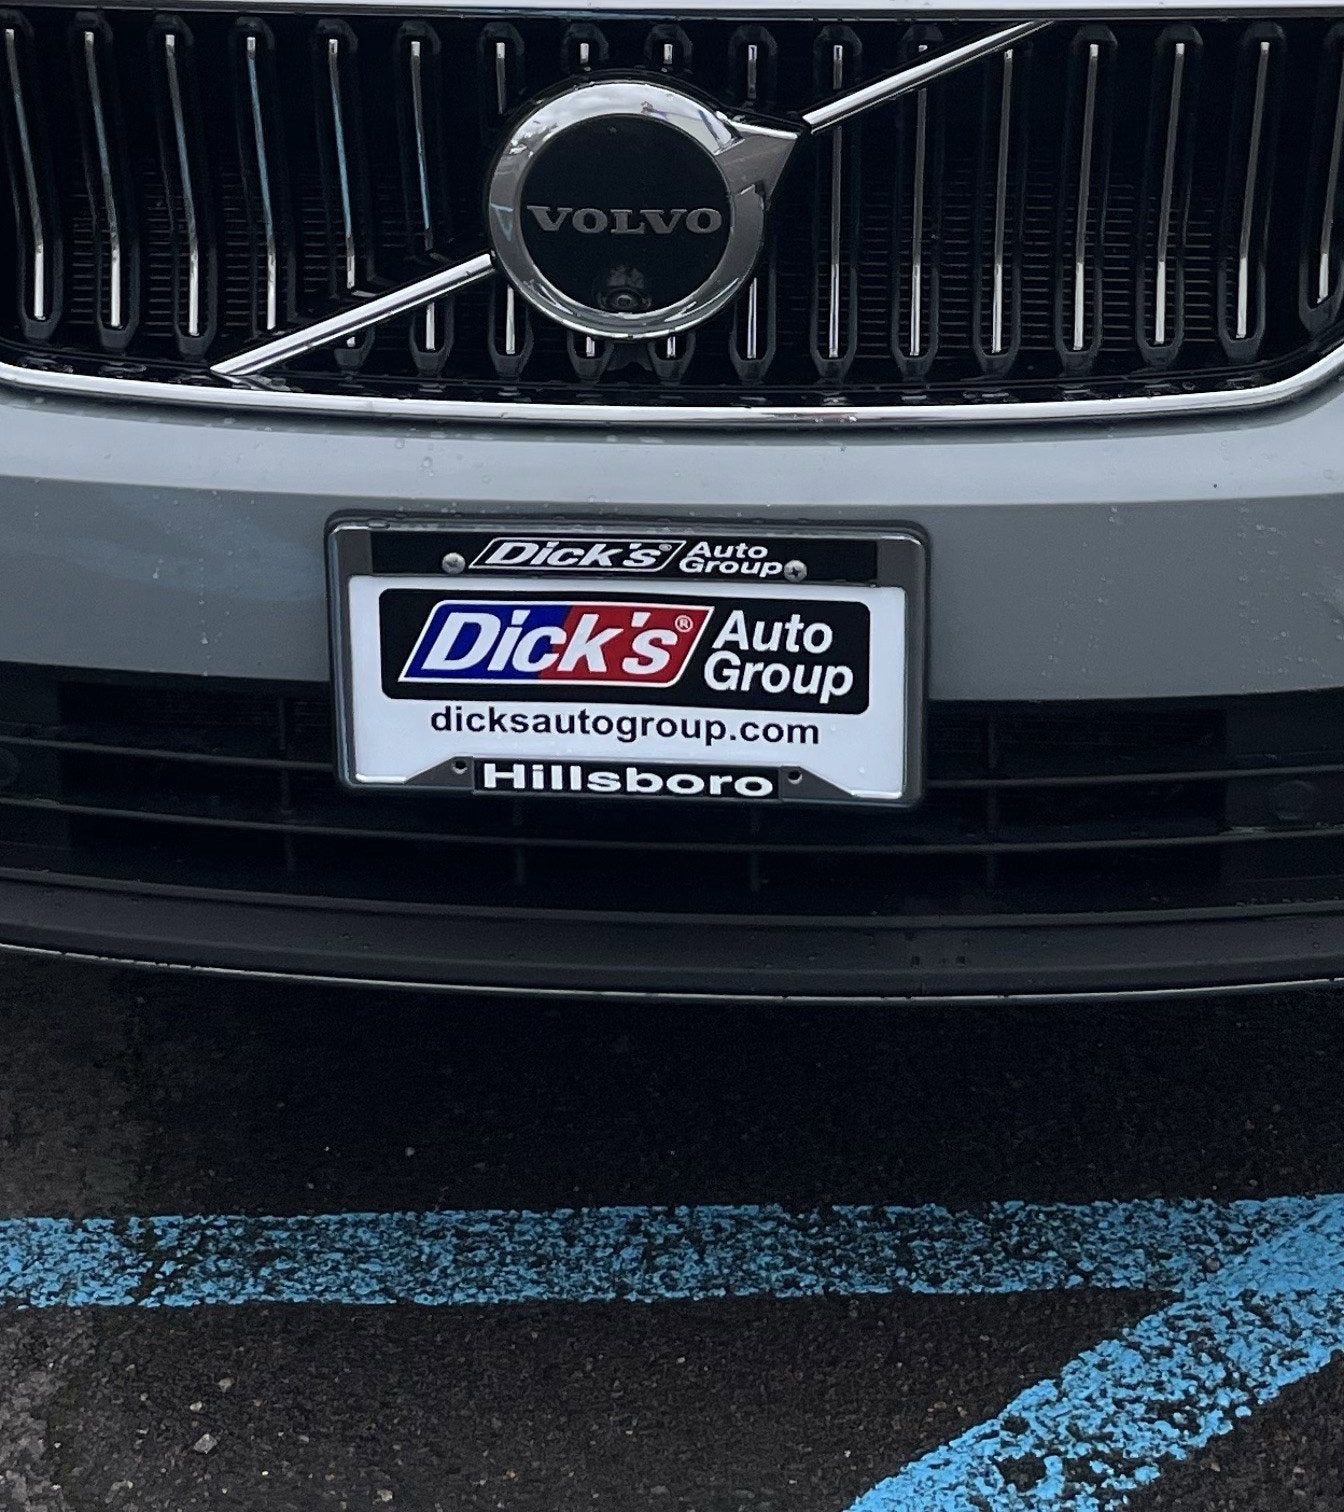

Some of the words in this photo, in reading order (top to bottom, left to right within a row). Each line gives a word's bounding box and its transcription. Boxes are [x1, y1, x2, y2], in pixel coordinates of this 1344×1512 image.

[526, 204, 723, 235] VOLVO
[485, 540, 662, 568] Dick's
[679, 556, 783, 578] Group
[686, 541, 768, 560] Auto
[712, 609, 833, 654] Auto
[703, 650, 854, 703] Group
[430, 705, 819, 746] dicksautogroup.com
[483, 762, 774, 797] Hillsboro
